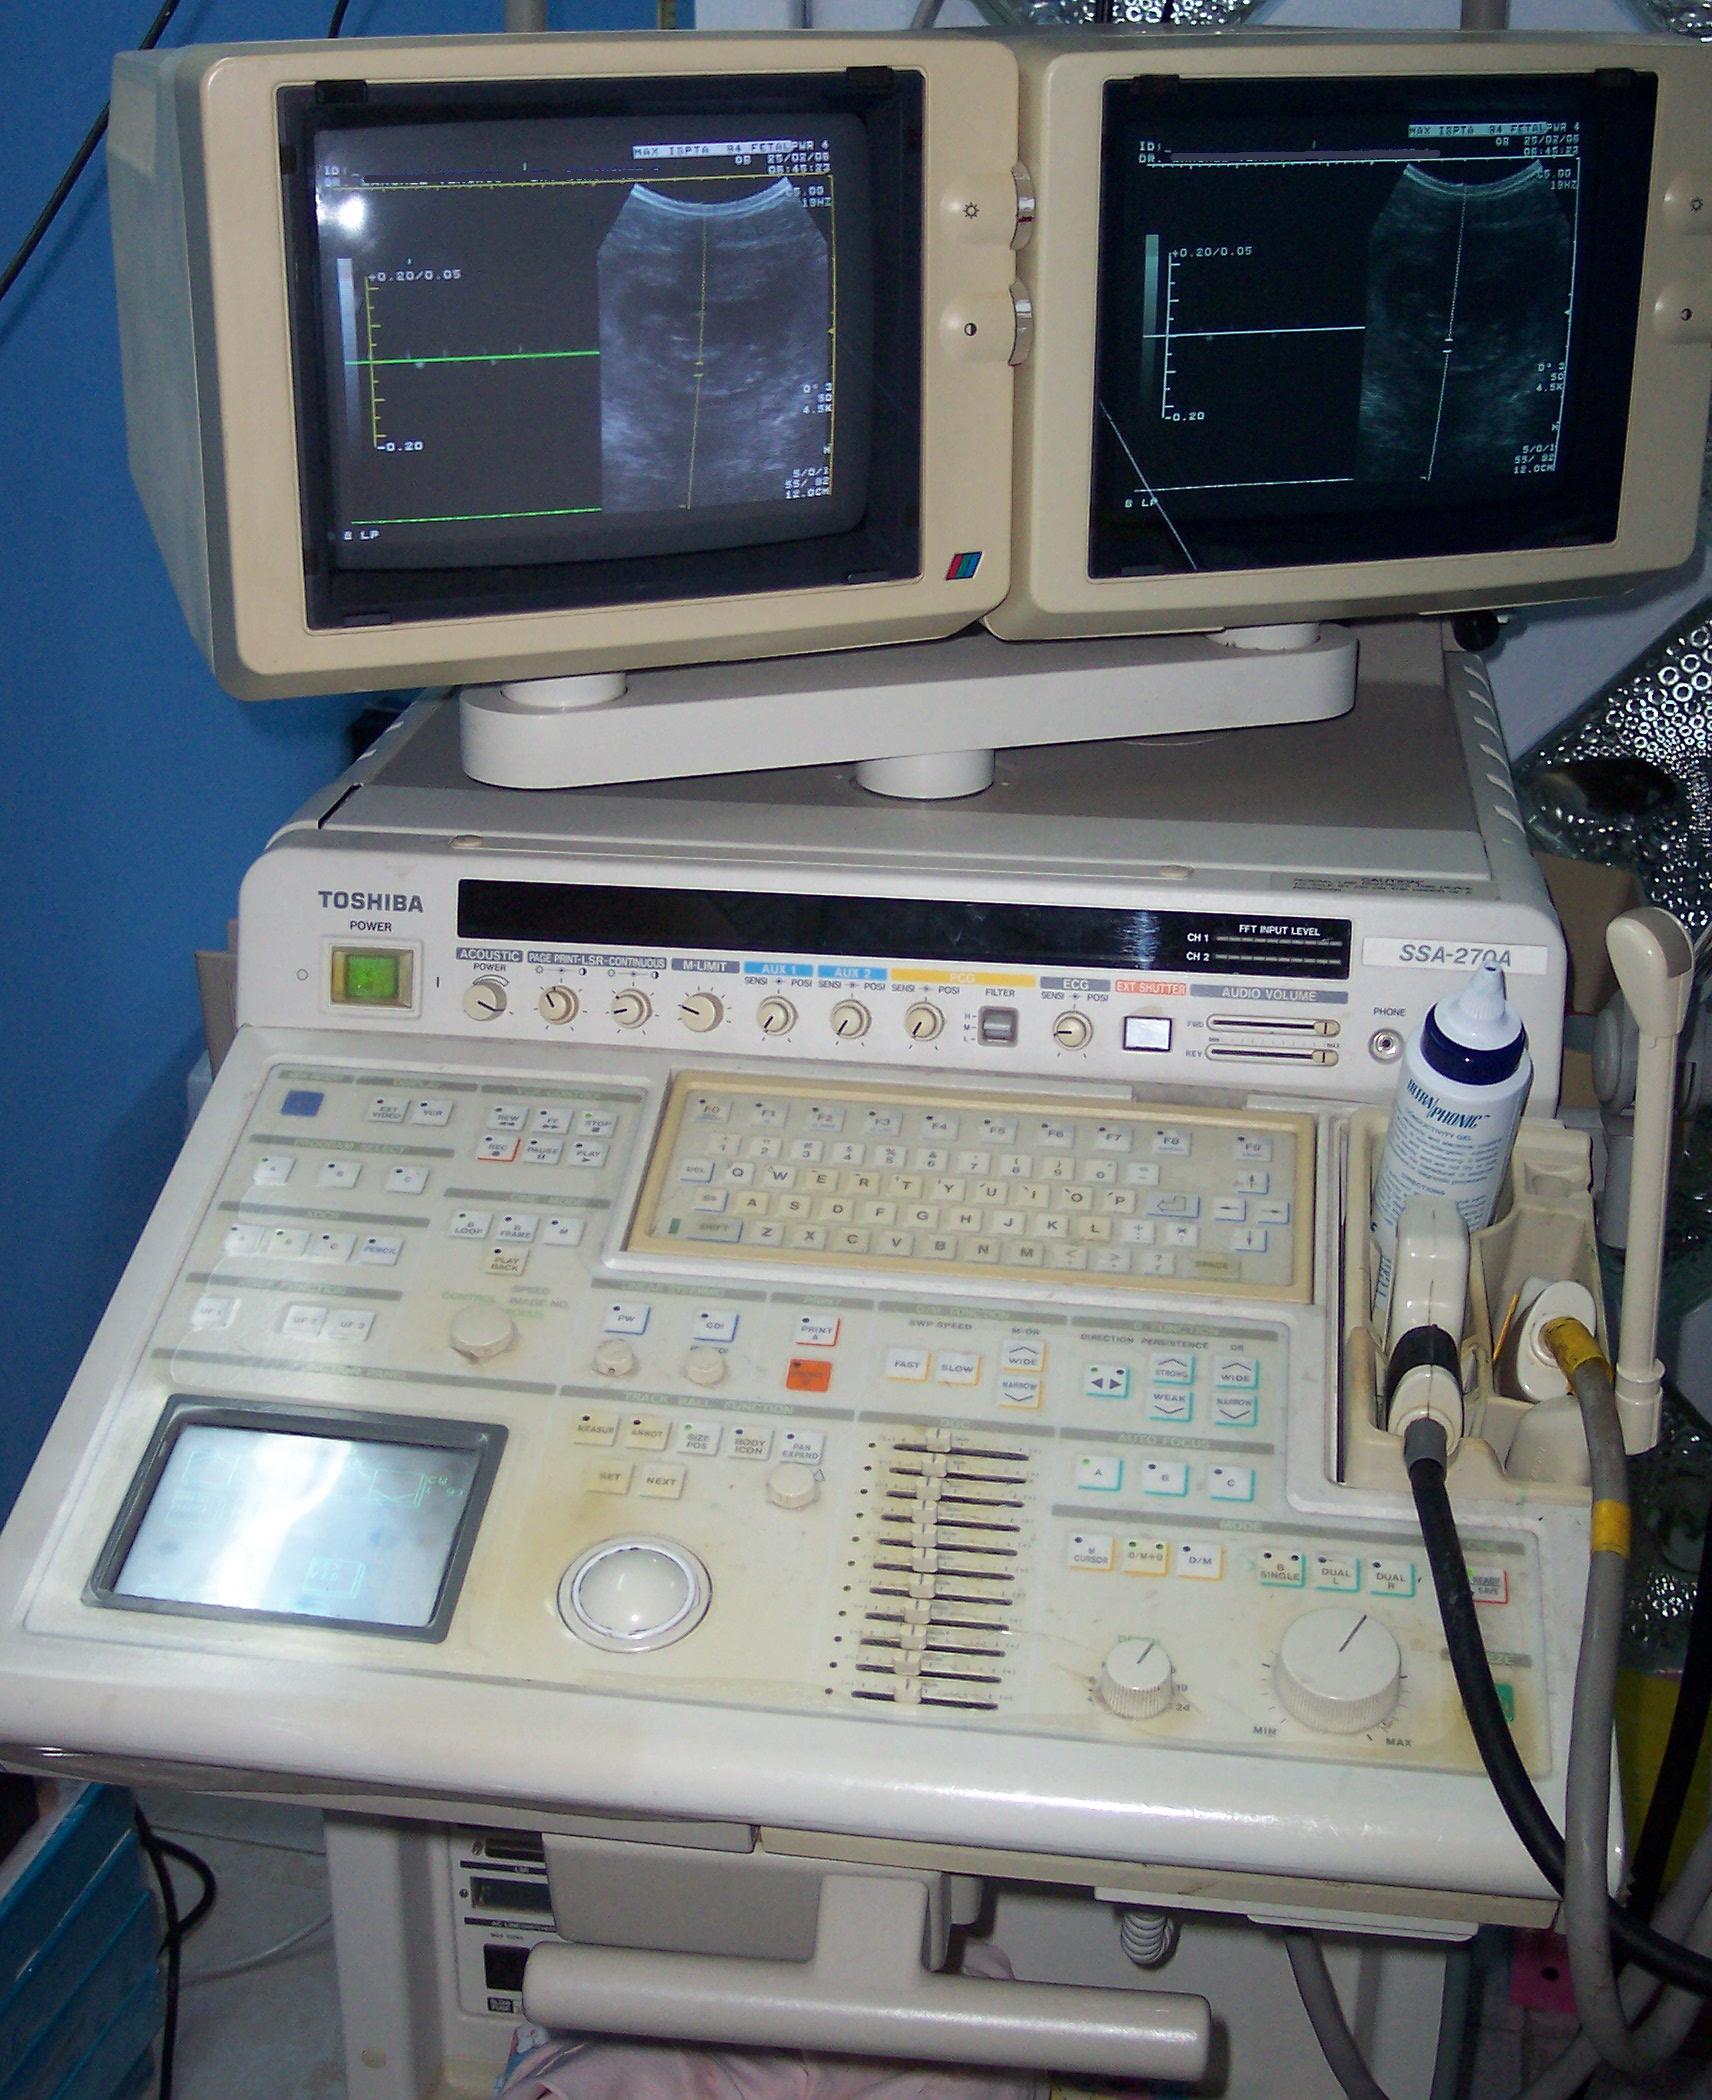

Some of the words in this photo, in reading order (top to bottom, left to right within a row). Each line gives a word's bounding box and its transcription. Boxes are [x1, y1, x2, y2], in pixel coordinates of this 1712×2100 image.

[1165, 412, 1205, 422] -0.20
[377, 441, 424, 452] -0.20
[318, 890, 424, 913] TOSHIBA
[350, 920, 392, 933] POWER
[1239, 924, 1258, 934] FFT
[1259, 925, 1289, 935] INPUT
[1291, 927, 1321, 937] LEVEL
[1187, 933, 1202, 943] CH
[1204, 934, 1209, 943] 1
[459, 948, 521, 962] ACOUSTIC
[528, 953, 551, 964] PAGE
[1186, 952, 1201, 961] CH
[1203, 953, 1210, 962] 2
[1399, 943, 1512, 967] SSA-270A
[473, 963, 507, 972] POWER
[682, 959, 728, 973] M-LIMIT
[760, 963, 788, 976] AUX
[791, 964, 797, 976] 1
[834, 967, 861, 979] AUX
[864, 968, 872, 980] 2
[1062, 978, 1090, 991] ECG
[1116, 981, 1138, 993] EXT
[1140, 983, 1186, 996] SHUTTER
[1221, 986, 1261, 999] AUDIO
[1266, 989, 1317, 1002] VOLUME
[1373, 1007, 1407, 1017] PHONE
[773, 1171, 788, 1181] W
[816, 1174, 827, 1184] E
[859, 1177, 869, 1187] R
[902, 1180, 912, 1190] T
[944, 1184, 955, 1193] Y
[986, 1187, 997, 1197] U
[747, 1198, 757, 1207] A
[1070, 1193, 1083, 1202] O
[1115, 1196, 1126, 1205] P
[790, 1200, 800, 1211] S
[833, 1204, 844, 1214] D
[875, 1207, 886, 1217] F
[916, 1211, 929, 1221] G
[960, 1214, 972, 1224] H
[1003, 1218, 1013, 1227] J
[1047, 1220, 1058, 1230] K
[1091, 1223, 1100, 1233] L
[762, 1227, 773, 1237] Z
[804, 1231, 815, 1241] X
[847, 1234, 858, 1244] C
[892, 1238, 902, 1247] V
[977, 1245, 989, 1255] N
[1020, 1247, 1033, 1258] M
[1080, 1333, 1135, 1344] DIRECTION
[1140, 1338, 1209, 1350] PERSISTENCE
[893, 1359, 920, 1371] FAST
[1008, 1357, 1038, 1367] WIDE
[941, 1363, 974, 1374] SLOW
[1220, 1374, 1250, 1382] WIDE
[1153, 1393, 1185, 1402] WEAK
[723, 1399, 793, 1414] FUNCTION
[687, 1433, 711, 1442] SIZE
[735, 1438, 766, 1447] BODY
[1118, 1433, 1149, 1446] AUTO
[1152, 1436, 1211, 1451] FOCUS
[686, 1441, 707, 1450] POS
[735, 1446, 764, 1454] ICON
[646, 1477, 677, 1486] NEXT
[1259, 1570, 1300, 1581] SINGLE
[1321, 1567, 1351, 1578] DUAL
[1376, 1572, 1407, 1583] DUAL
[1253, 1725, 1278, 1736] MIN
[1385, 1736, 1413, 1748] MAX
